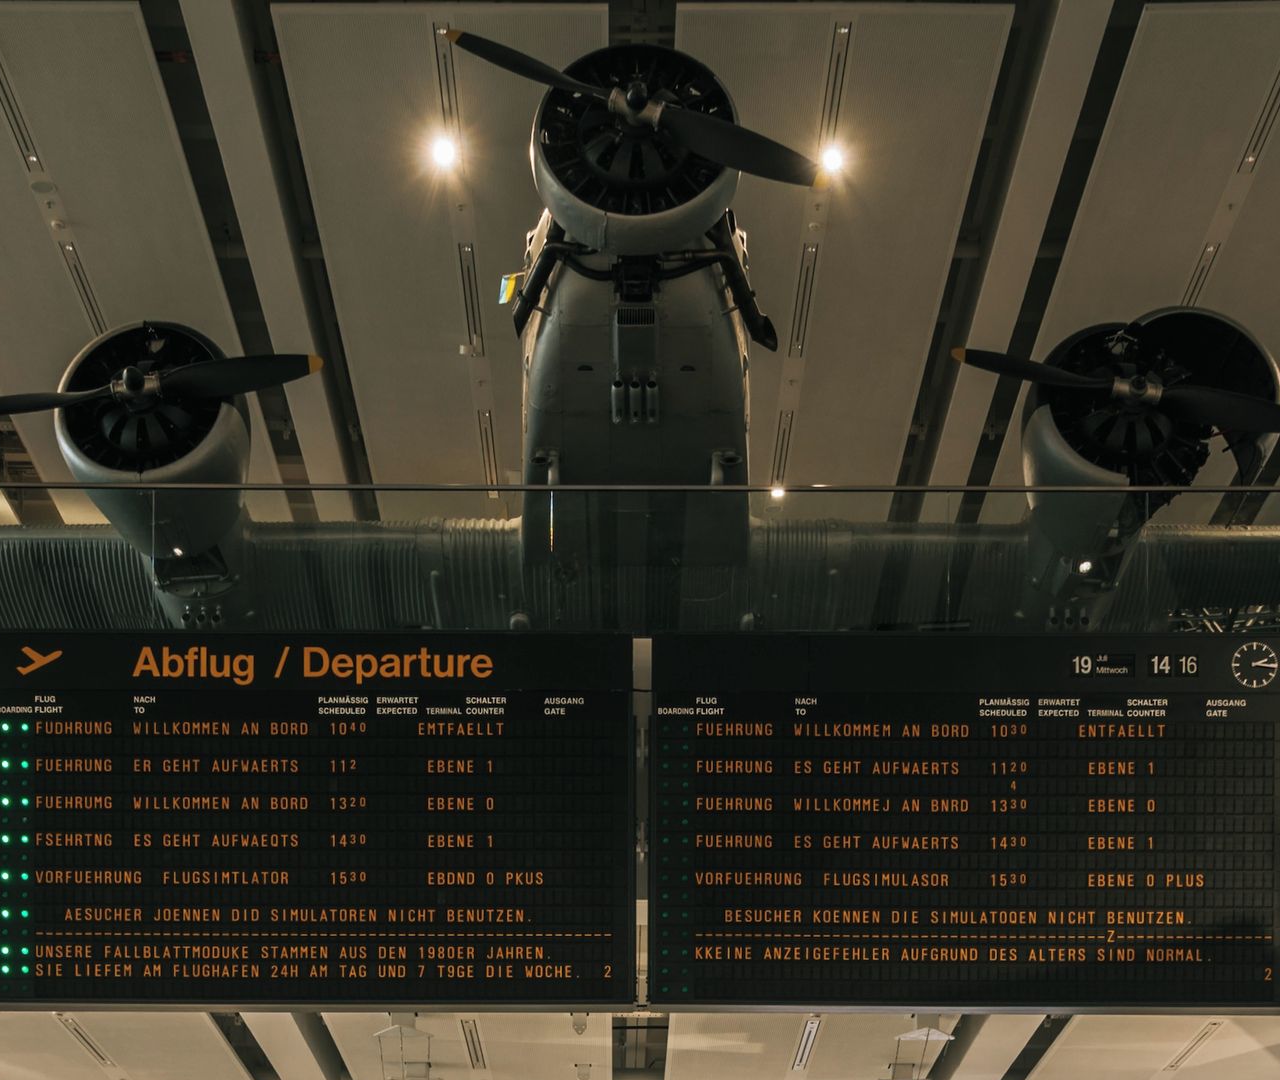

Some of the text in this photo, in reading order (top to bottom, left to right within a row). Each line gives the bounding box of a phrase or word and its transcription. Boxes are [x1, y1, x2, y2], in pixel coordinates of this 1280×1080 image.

[132, 646, 494, 685] Abflug / Departure
[1072, 656, 1092, 674] 19
[1096, 666, 1128, 674] Mittwoch
[1151, 656, 1197, 674] 14 16
[34, 695, 56, 703] FLUG
[133, 695, 156, 704] NACH
[318, 695, 369, 704] PLANMÄSSIG
[376, 696, 419, 704] ERWARTET
[465, 696, 507, 705] SCHALTER
[544, 697, 585, 705] AUSGANG
[34, 705, 64, 714] FLIGHT
[134, 706, 146, 714] TO
[318, 706, 366, 715] SCHEDULED
[376, 707, 418, 715] EXPECTED
[425, 707, 463, 715] TERMINAL
[465, 707, 505, 715] COUNTER
[543, 707, 566, 715] GATE
[35, 721, 113, 735] FUDHRUNG
[133, 721, 230, 736] WILLKOMMEN
[241, 722, 259, 735] AN
[270, 722, 309, 736] BORD
[35, 758, 112, 772] FUEHRUNG
[133, 759, 151, 772] ER
[162, 759, 200, 773] GEHT
[211, 759, 299, 773] AUFWAERTS
[427, 759, 473, 774] EBENE
[486, 760, 493, 773] 1
[133, 796, 230, 810] WILLKOMMEN
[241, 796, 259, 810] AN
[270, 796, 308, 810] BORD
[427, 797, 474, 811] EBENE
[696, 797, 773, 811] FUEHRUNG
[793, 798, 890, 812] WILLKOMMEJ
[901, 798, 920, 812] AN
[930, 799, 969, 813] BNRD
[1088, 798, 1135, 813] EBENE
[35, 832, 113, 847] FSEHRTNG
[133, 833, 152, 847] ES
[162, 833, 200, 848] GEHT
[427, 834, 474, 848] EBENE
[486, 834, 494, 848] 1
[35, 870, 142, 885] VORFUEHRUNG
[163, 870, 289, 885] FLUGSIMTLATOR
[505, 871, 544, 886] PKUS
[695, 871, 802, 886] VORFUEHRUNG
[823, 872, 949, 887] FLUGSIMULASOR
[1087, 873, 1135, 888] EBENE
[1165, 873, 1205, 888] PLUS
[64, 907, 532, 923] AESUCHER JOENNEN DID SIMULATOREN NICHT BENUTZEN.
[724, 909, 802, 923] BESUCHER
[812, 909, 881, 924] KOENNEN
[891, 910, 919, 925] DIE
[1047, 910, 1096, 925] NICHT
[1106, 910, 1192, 925] BENUTZEN.
[35, 944, 92, 959] UNSERE
[260, 945, 329, 959] STAMMEN
[339, 945, 367, 960] AUS
[378, 945, 407, 960] DEN
[419, 945, 475, 960] 1980ER
[486, 946, 551, 960] JAHREN.
[695, 946, 1212, 962] KKEINE ANZEIGEFEHLER AUFGRUND DES ALTERS SIND NORMAL.
[35, 963, 63, 977] SIE
[143, 963, 162, 977] AM
[173, 963, 260, 978] FLUGHAFEN
[271, 964, 299, 978] 24H
[309, 964, 328, 978] AM
[339, 964, 367, 978] TAG
[378, 964, 406, 978] UND
[417, 964, 426, 977] 7
[437, 964, 474, 979] T9GE
[485, 964, 513, 979] DIE
[524, 964, 580, 979] WOCHE.
[602, 964, 613, 978] 2
